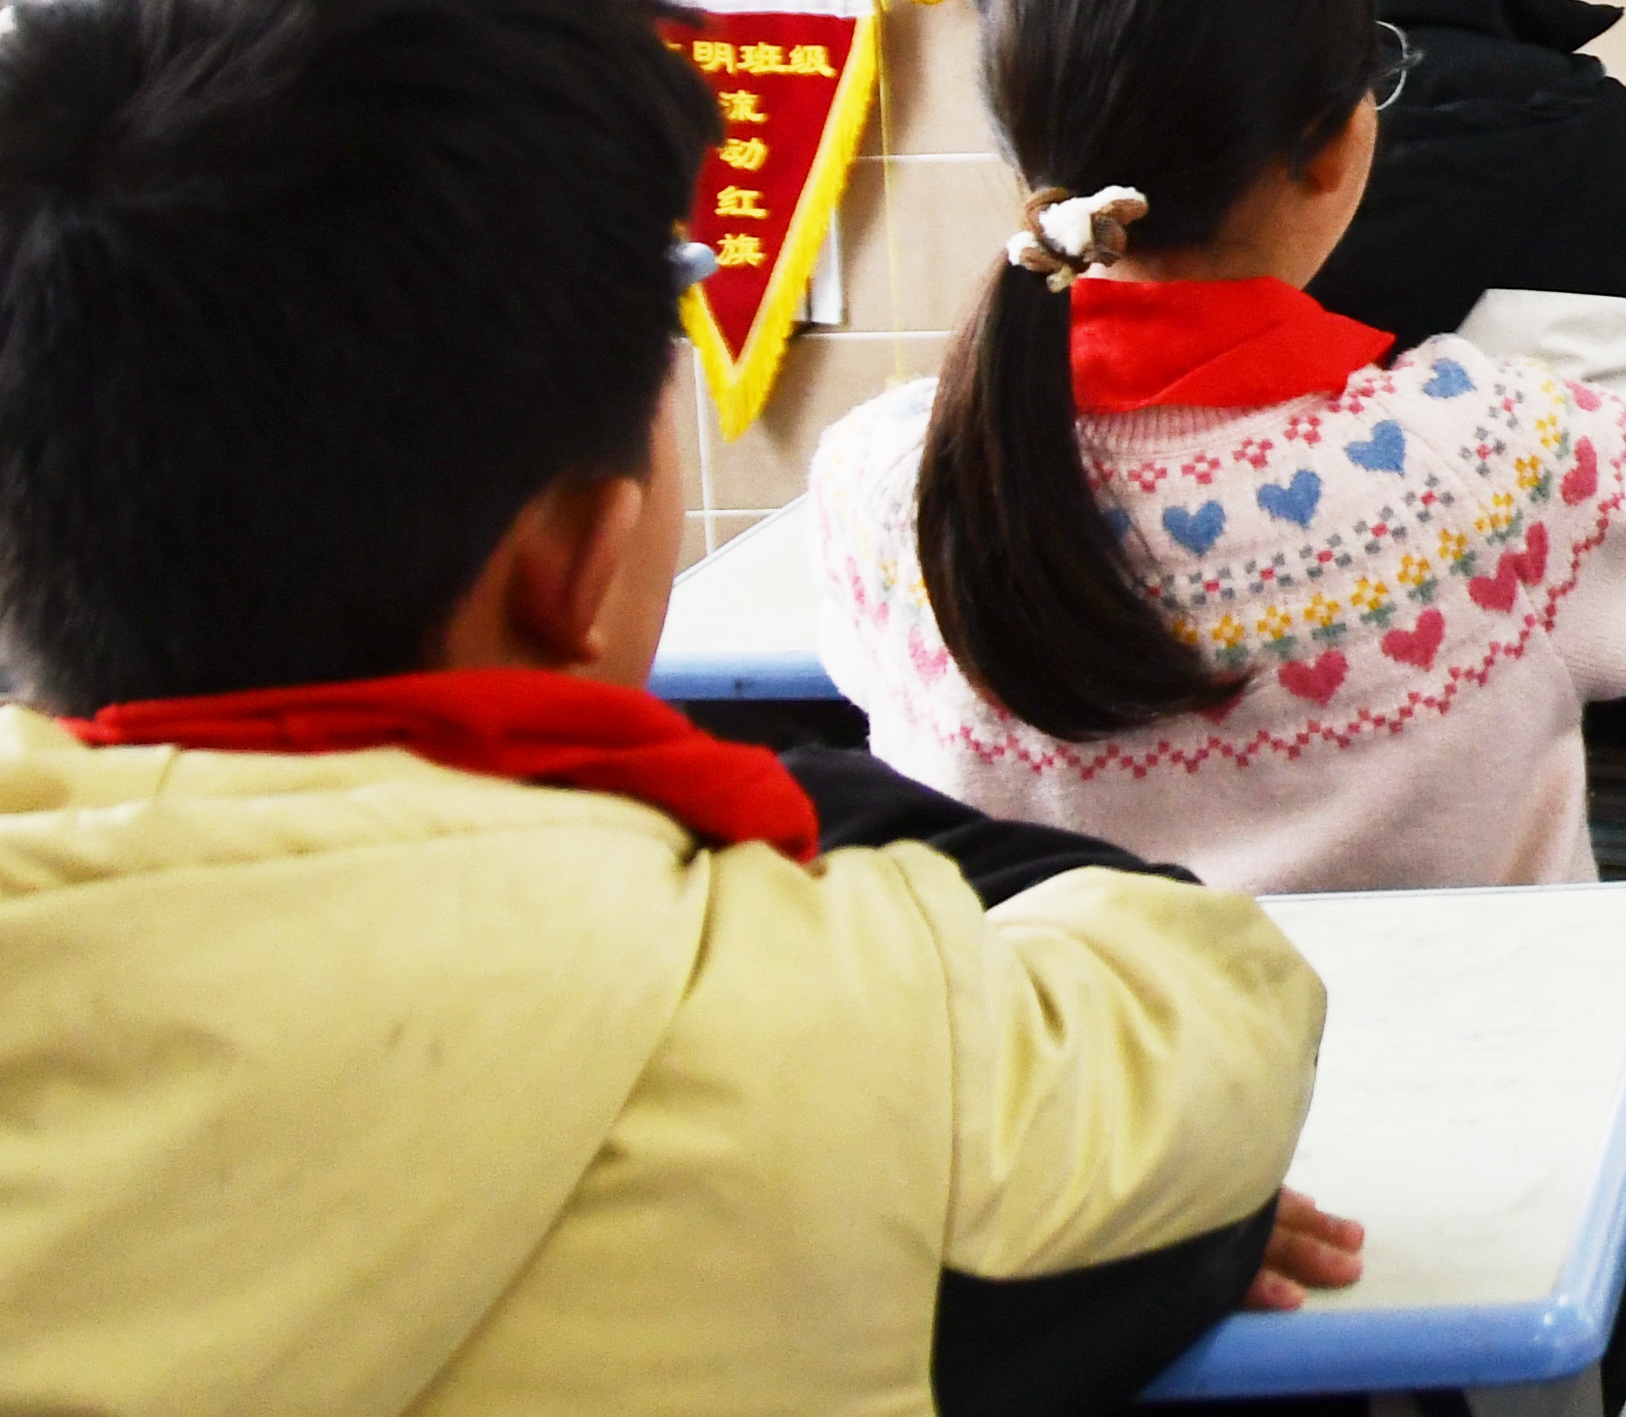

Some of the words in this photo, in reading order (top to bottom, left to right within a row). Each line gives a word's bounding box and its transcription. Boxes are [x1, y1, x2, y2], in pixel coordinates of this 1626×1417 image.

[668, 39, 837, 79] 明班级
[714, 89, 769, 269] 流动红旗
